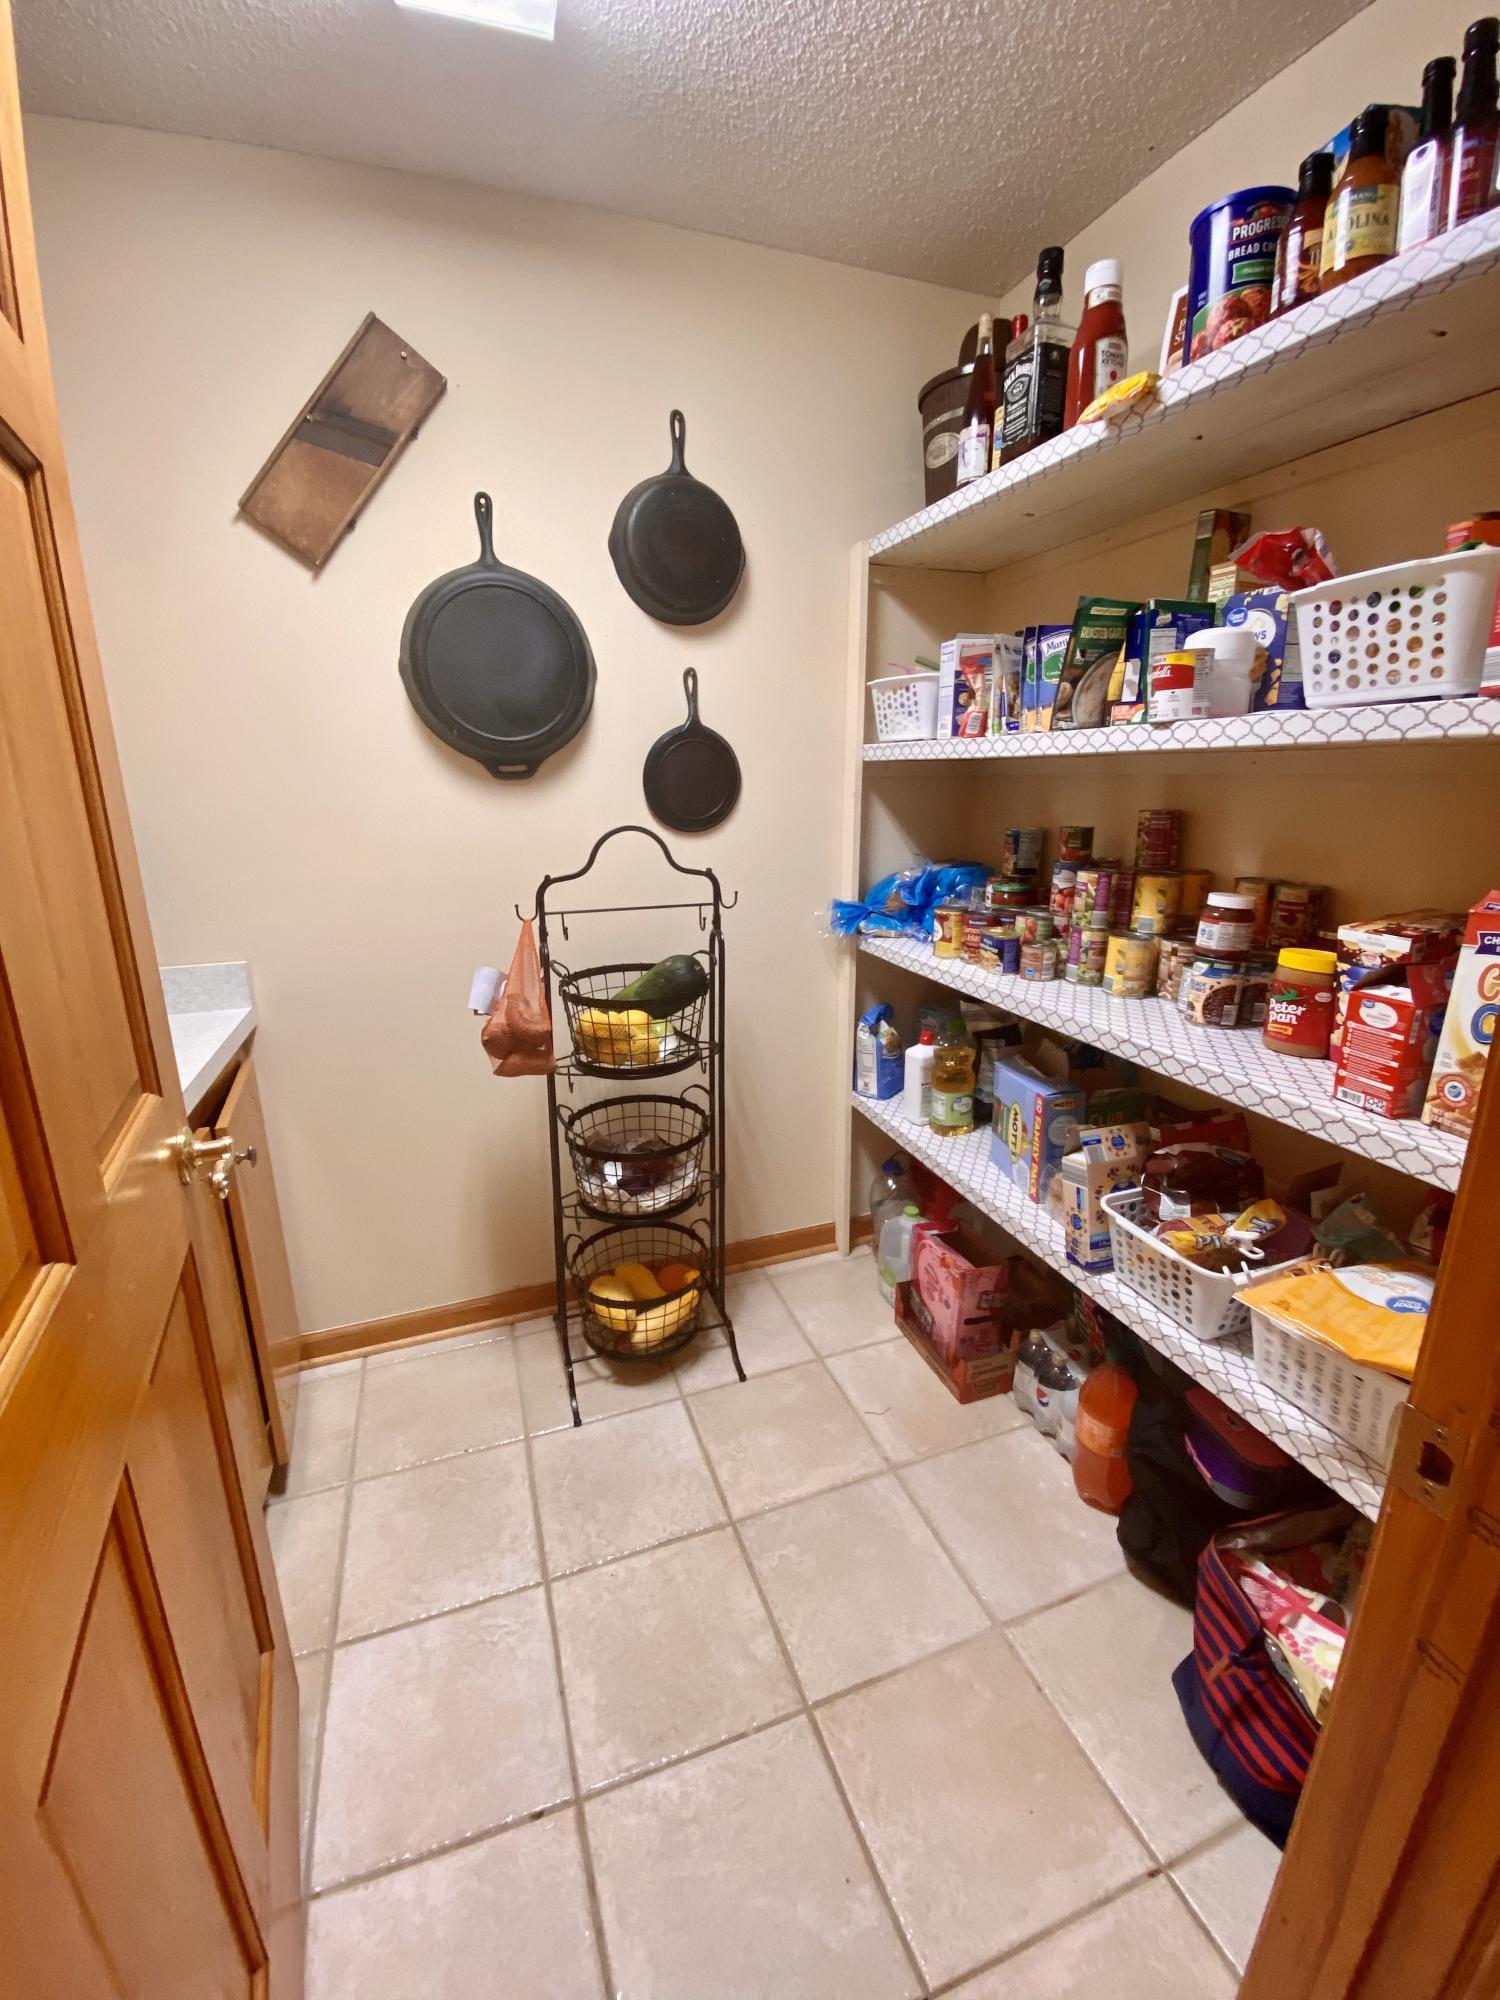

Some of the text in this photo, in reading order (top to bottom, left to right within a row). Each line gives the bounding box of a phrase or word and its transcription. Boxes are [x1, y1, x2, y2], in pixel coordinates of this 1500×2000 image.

[1228, 242, 1260, 261] BREAD
[1080, 626, 1108, 639] ROASTED
[1484, 936, 1500, 945] CH
[1269, 998, 1308, 1016] Peter
[1032, 1115, 1042, 1162] FAMILY
[1029, 1163, 1038, 1197] PACK
